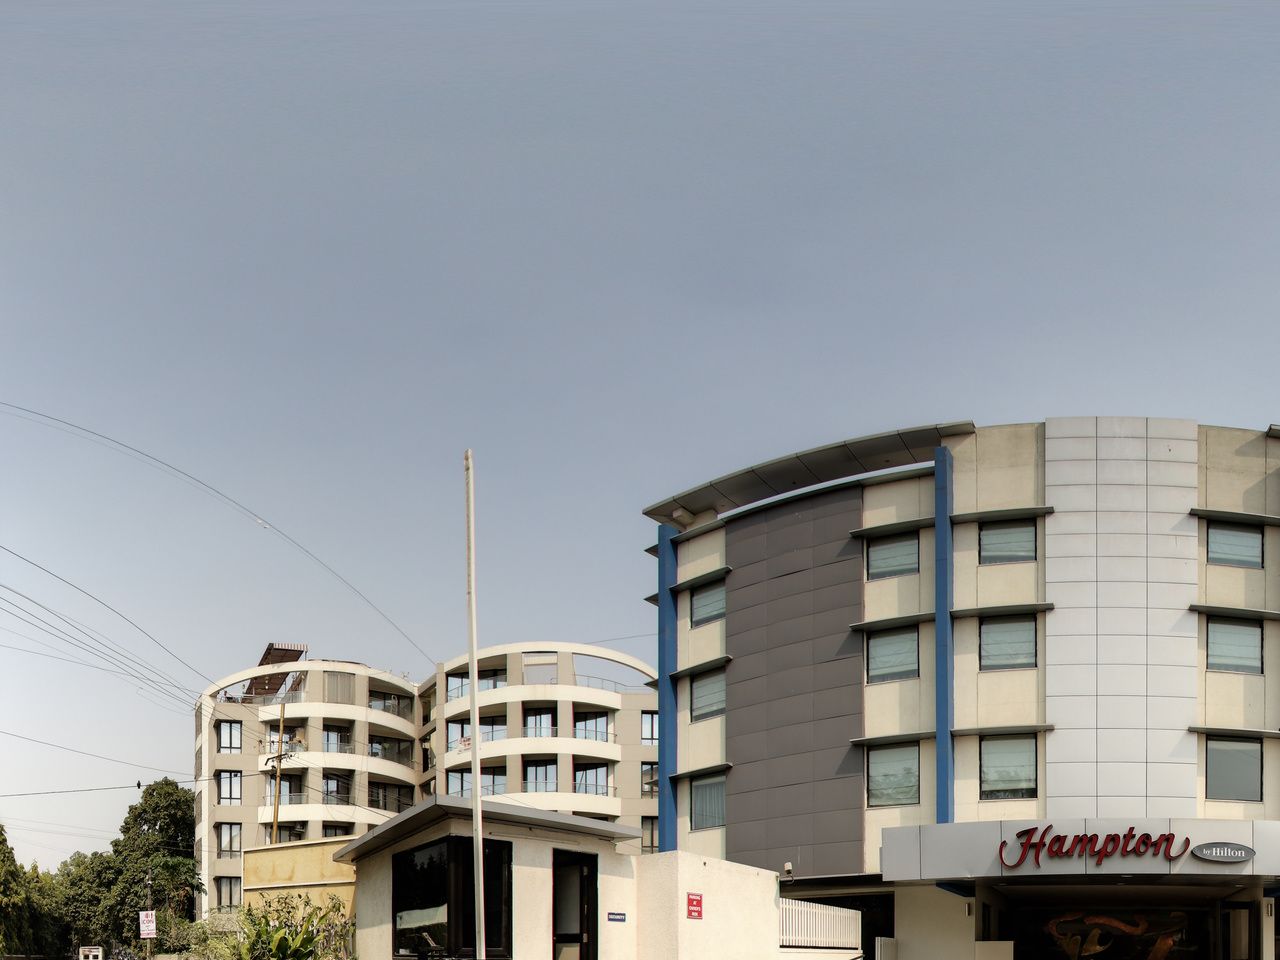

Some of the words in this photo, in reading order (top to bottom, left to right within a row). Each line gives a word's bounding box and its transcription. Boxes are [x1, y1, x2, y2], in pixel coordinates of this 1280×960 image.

[999, 824, 1190, 868] Hampton
[1203, 848, 1211, 856] by
[1212, 847, 1245, 857] Hilton
